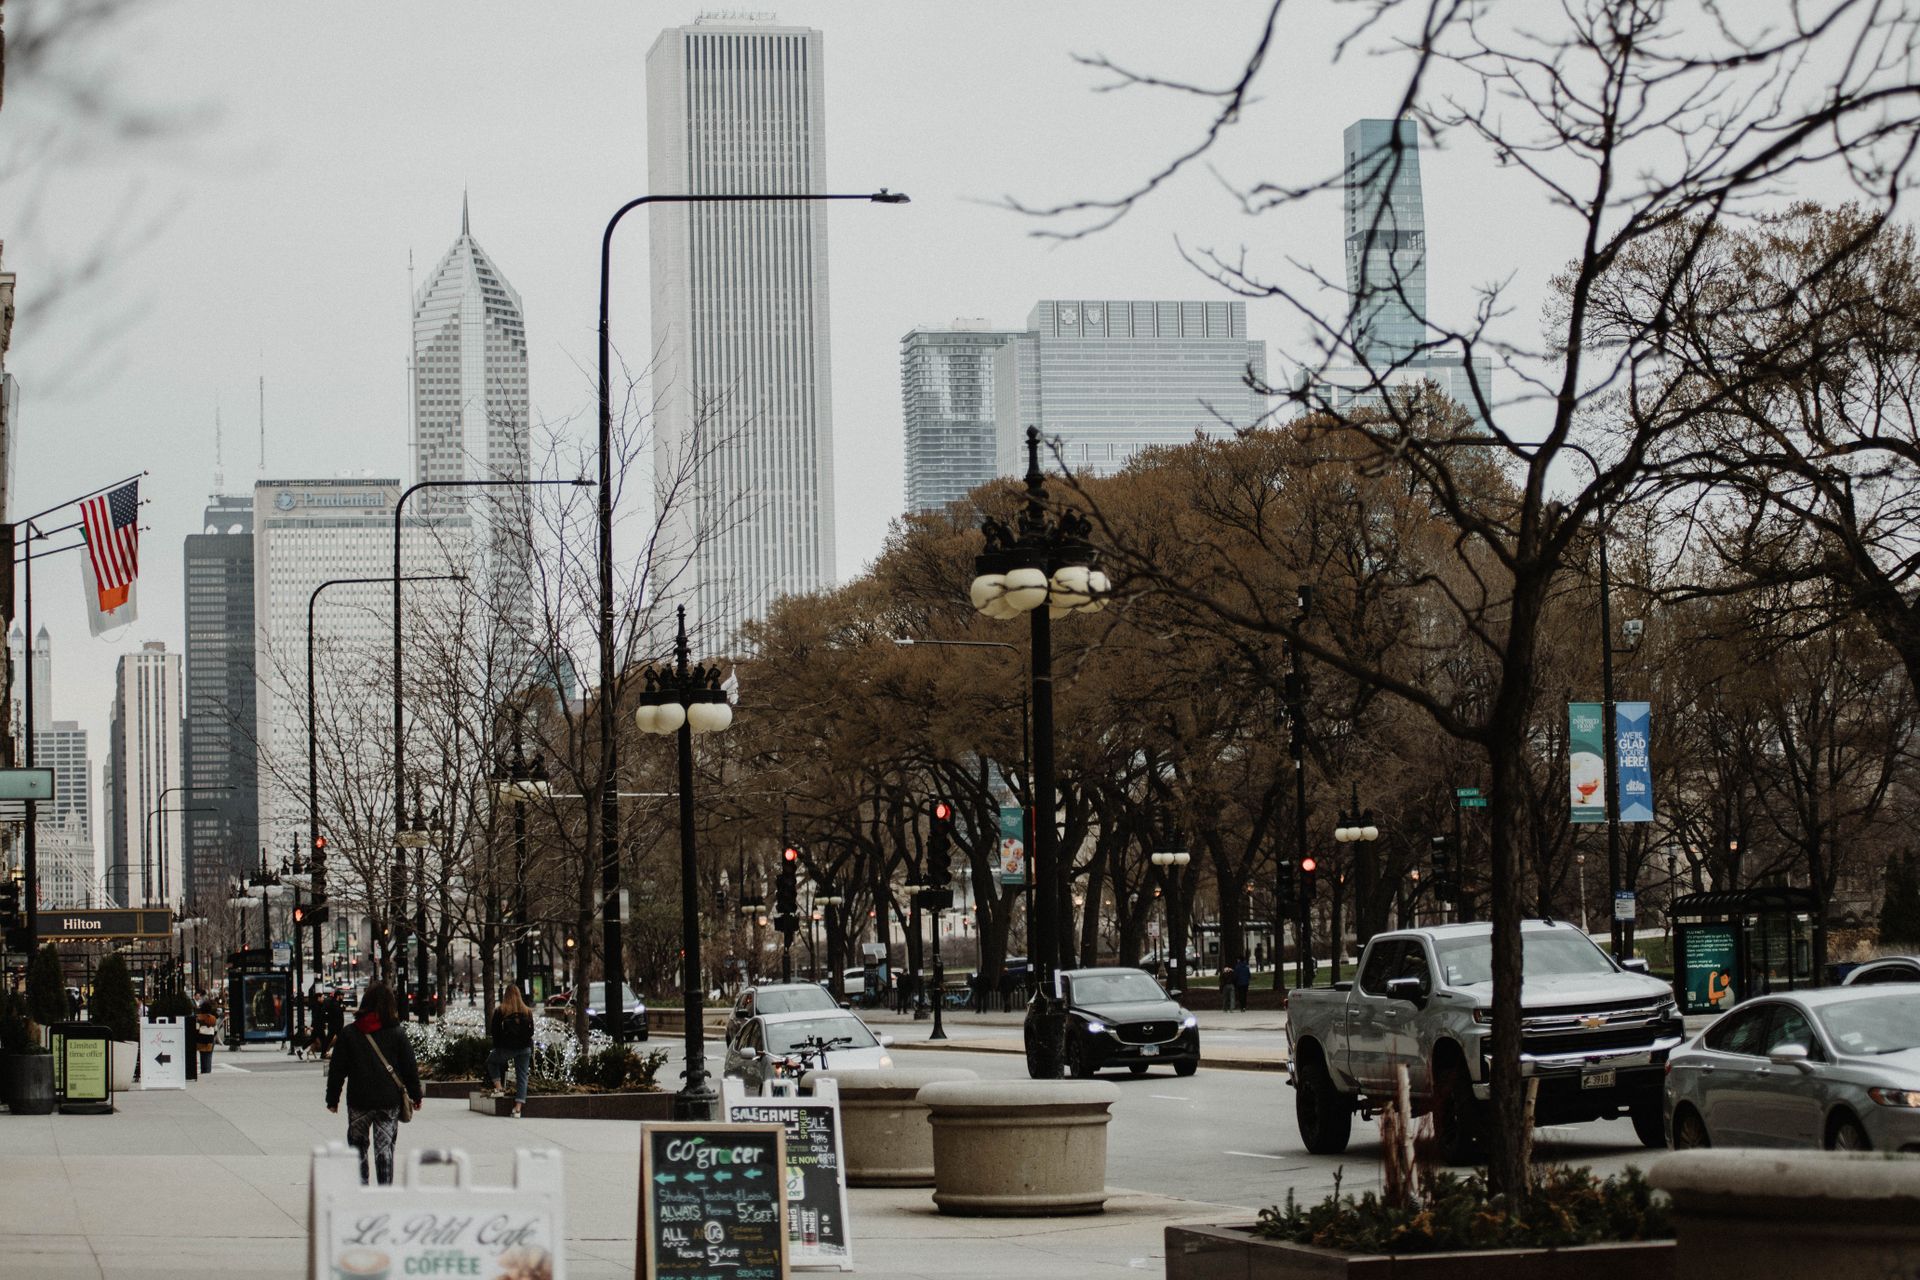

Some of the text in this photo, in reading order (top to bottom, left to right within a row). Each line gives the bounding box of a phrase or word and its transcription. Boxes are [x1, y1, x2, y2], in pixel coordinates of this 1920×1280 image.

[303, 490, 385, 507] Prudential
[1622, 731, 1643, 739] WE'RE
[1618, 739, 1646, 749] GLAD
[1621, 748, 1645, 756] YOU'RE
[1620, 756, 1649, 772] HERE!
[63, 918, 102, 930] Hilton
[69, 1041, 98, 1050] Limited
[69, 1050, 103, 1058] time offer
[732, 1107, 760, 1121] SALE
[759, 1109, 800, 1122] GAME
[800, 1109, 808, 1140] SPIKED
[807, 1117, 828, 1130] SALE
[810, 1144, 830, 1153] ONLY
[798, 1156, 818, 1165] NOW
[660, 1204, 701, 1218] ALWAYS
[790, 1208, 799, 1232] GAME
[342, 1213, 391, 1246] Le
[662, 1227, 689, 1242] ALL
[404, 1256, 482, 1276] COFFEE
